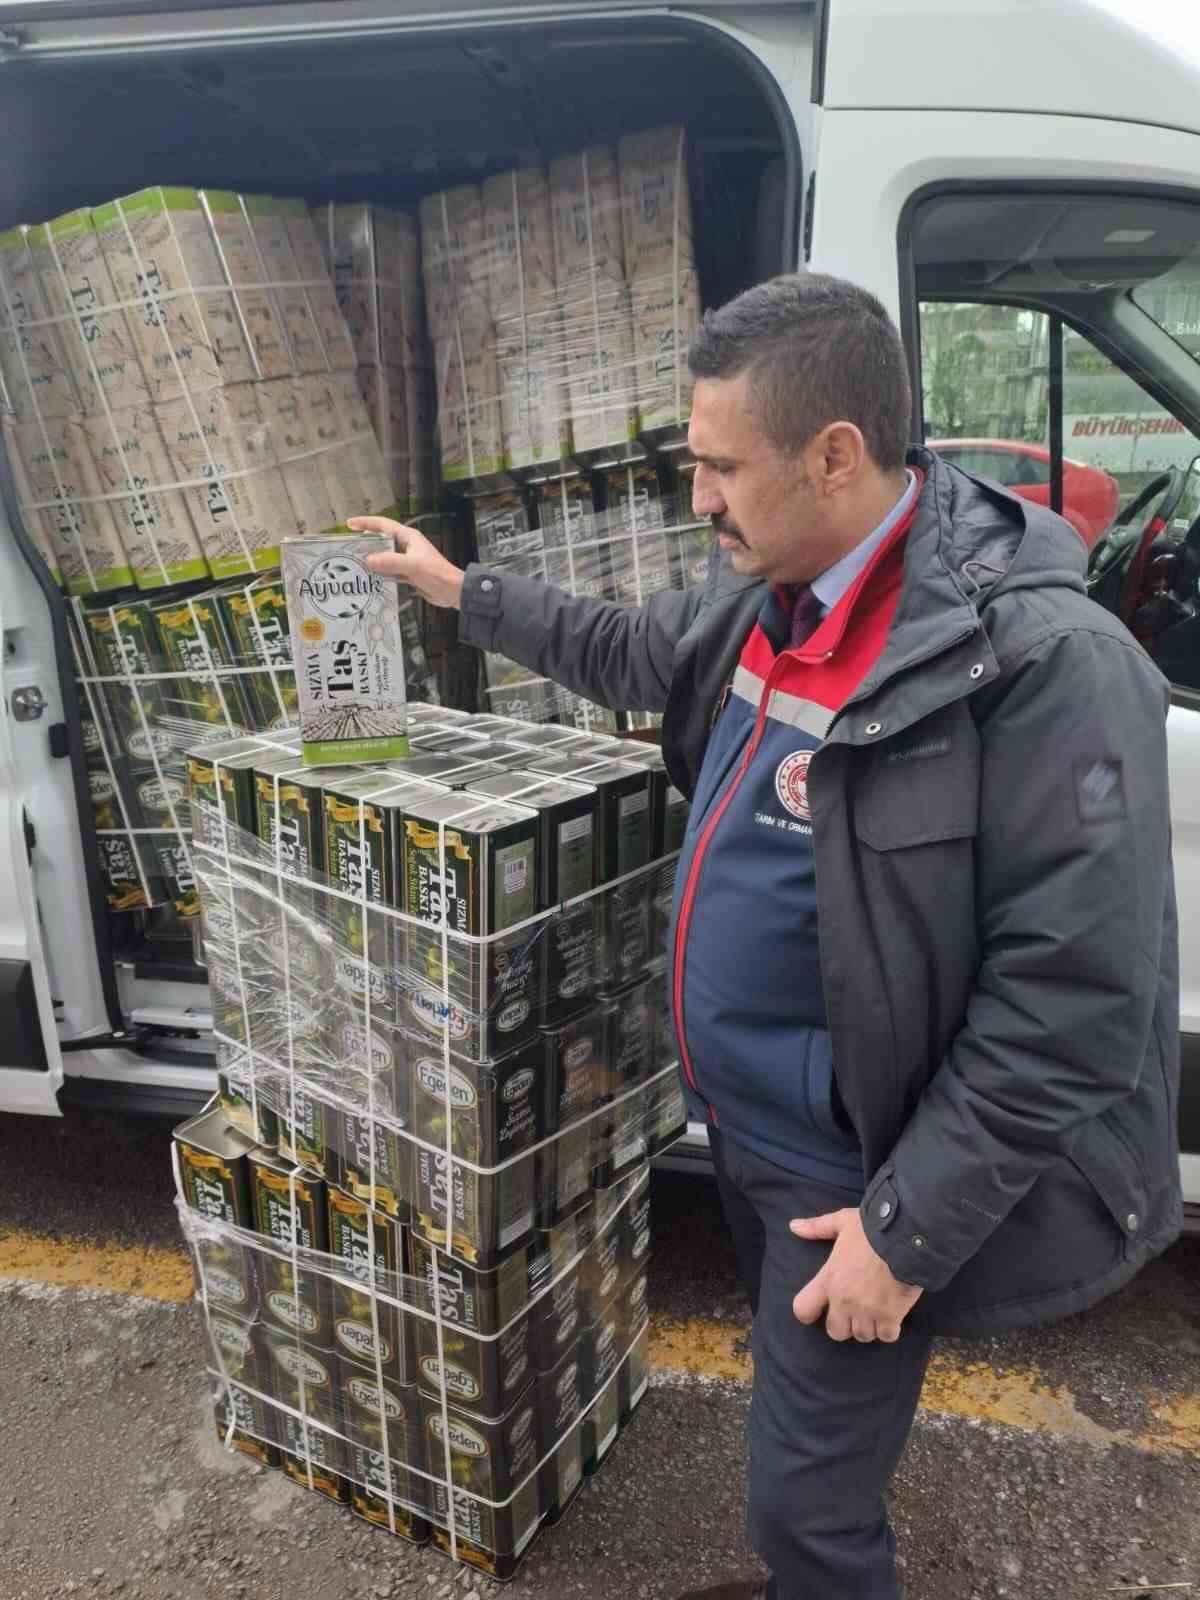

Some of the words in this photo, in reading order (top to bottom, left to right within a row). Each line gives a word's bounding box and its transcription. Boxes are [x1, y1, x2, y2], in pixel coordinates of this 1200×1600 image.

[299, 575, 382, 603] Ayvalık
[307, 653, 323, 700] SIZMA
[327, 640, 358, 699] Taş
[357, 652, 370, 694] BASKI
[337, 838, 348, 882] BASKI
[418, 865, 429, 912] BASKI
[432, 1419, 481, 1451] Eeden
